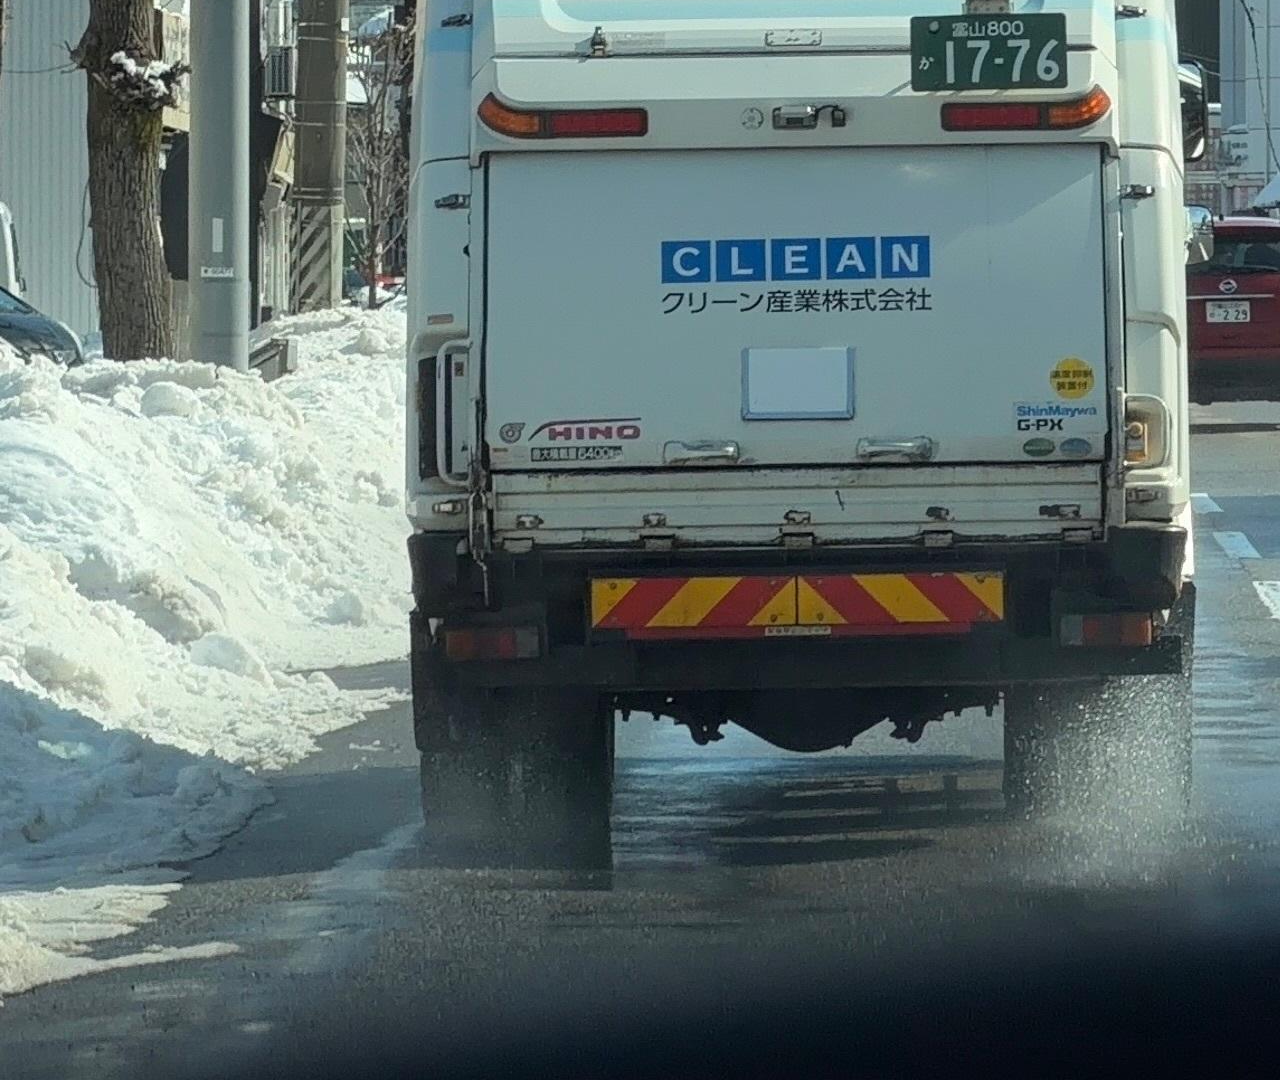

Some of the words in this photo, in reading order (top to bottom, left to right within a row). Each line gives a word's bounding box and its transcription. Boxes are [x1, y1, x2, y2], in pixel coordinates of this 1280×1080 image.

[945, 38, 1060, 84] 17-76
[672, 243, 920, 276] CLEAN
[662, 287, 932, 314] クリーン産業株式会社
[1017, 405, 1097, 418] ShinMaywa
[548, 425, 641, 441] HINO
[1017, 419, 1064, 431] G-PX
